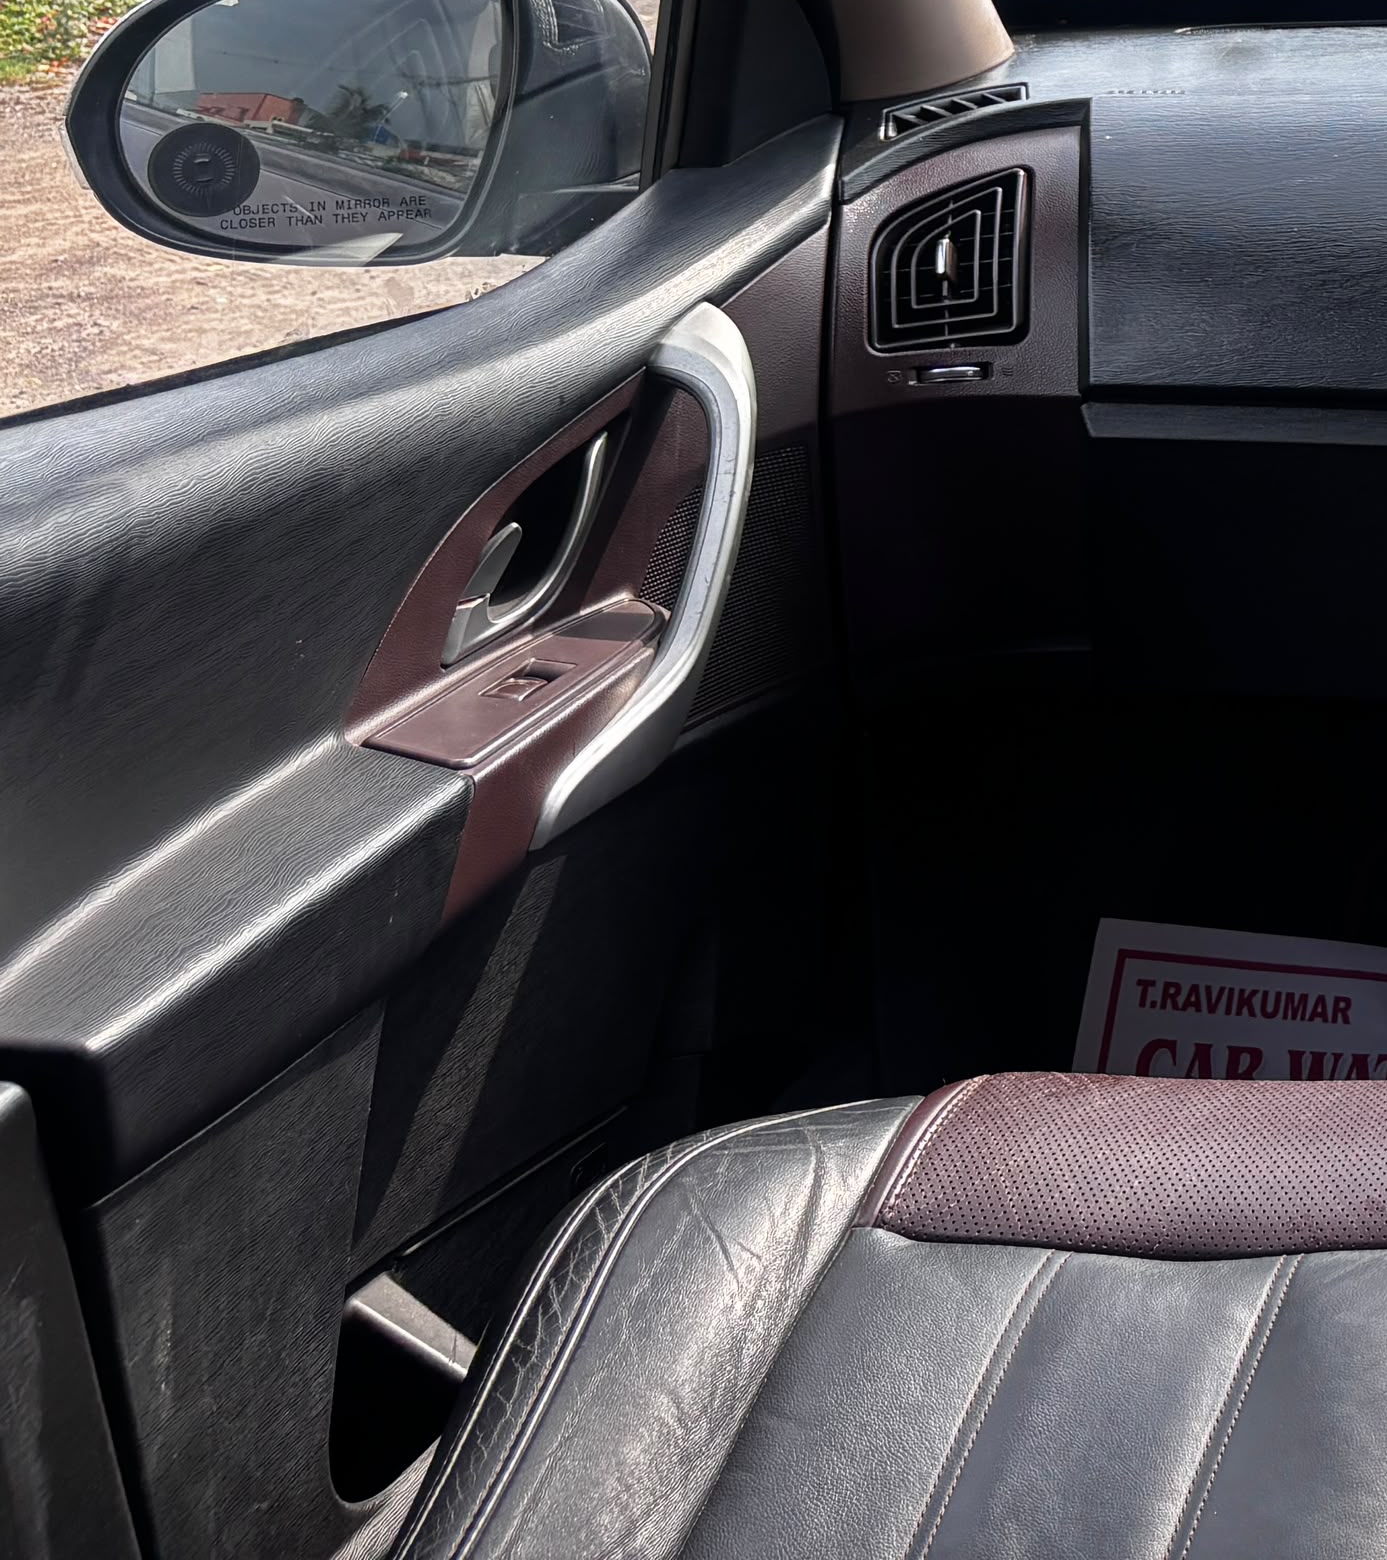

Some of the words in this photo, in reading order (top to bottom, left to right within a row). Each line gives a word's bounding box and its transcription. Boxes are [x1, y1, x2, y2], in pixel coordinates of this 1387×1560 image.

[220, 217, 276, 230] CLOSER
[287, 214, 323, 227] THAN
[333, 212, 369, 224] THEY
[377, 208, 432, 221] APPEAR
[232, 202, 298, 217] OBJECTS
[308, 200, 326, 212] IN
[335, 198, 390, 210] MIRROR
[400, 195, 427, 207] ARE
[1135, 978, 1352, 1025] T.RAVIKUMAR
[1135, 1038, 1263, 1079] CAR
